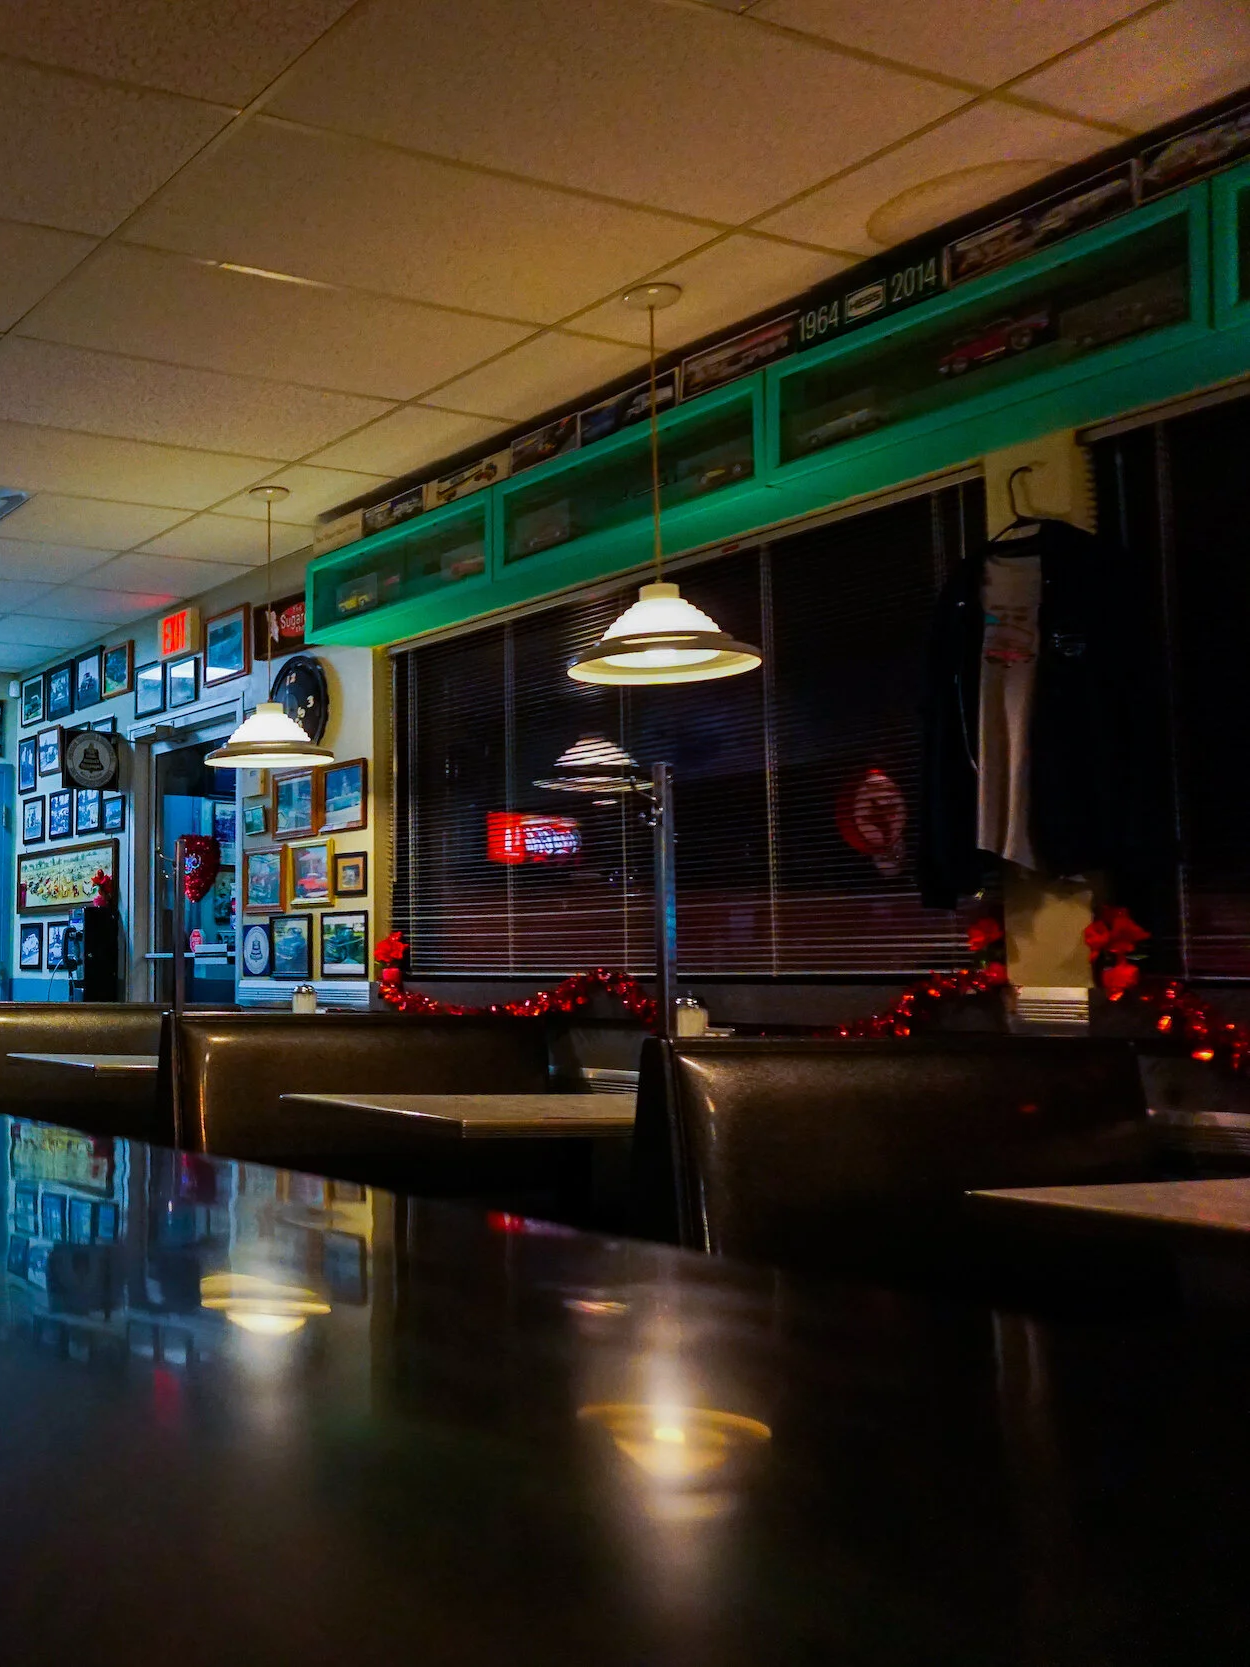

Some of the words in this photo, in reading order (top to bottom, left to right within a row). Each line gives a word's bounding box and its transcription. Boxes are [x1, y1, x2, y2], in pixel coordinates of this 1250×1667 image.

[798, 301, 840, 342] 1964
[892, 257, 938, 302] 2014
[162, 610, 187, 655] EXIT
